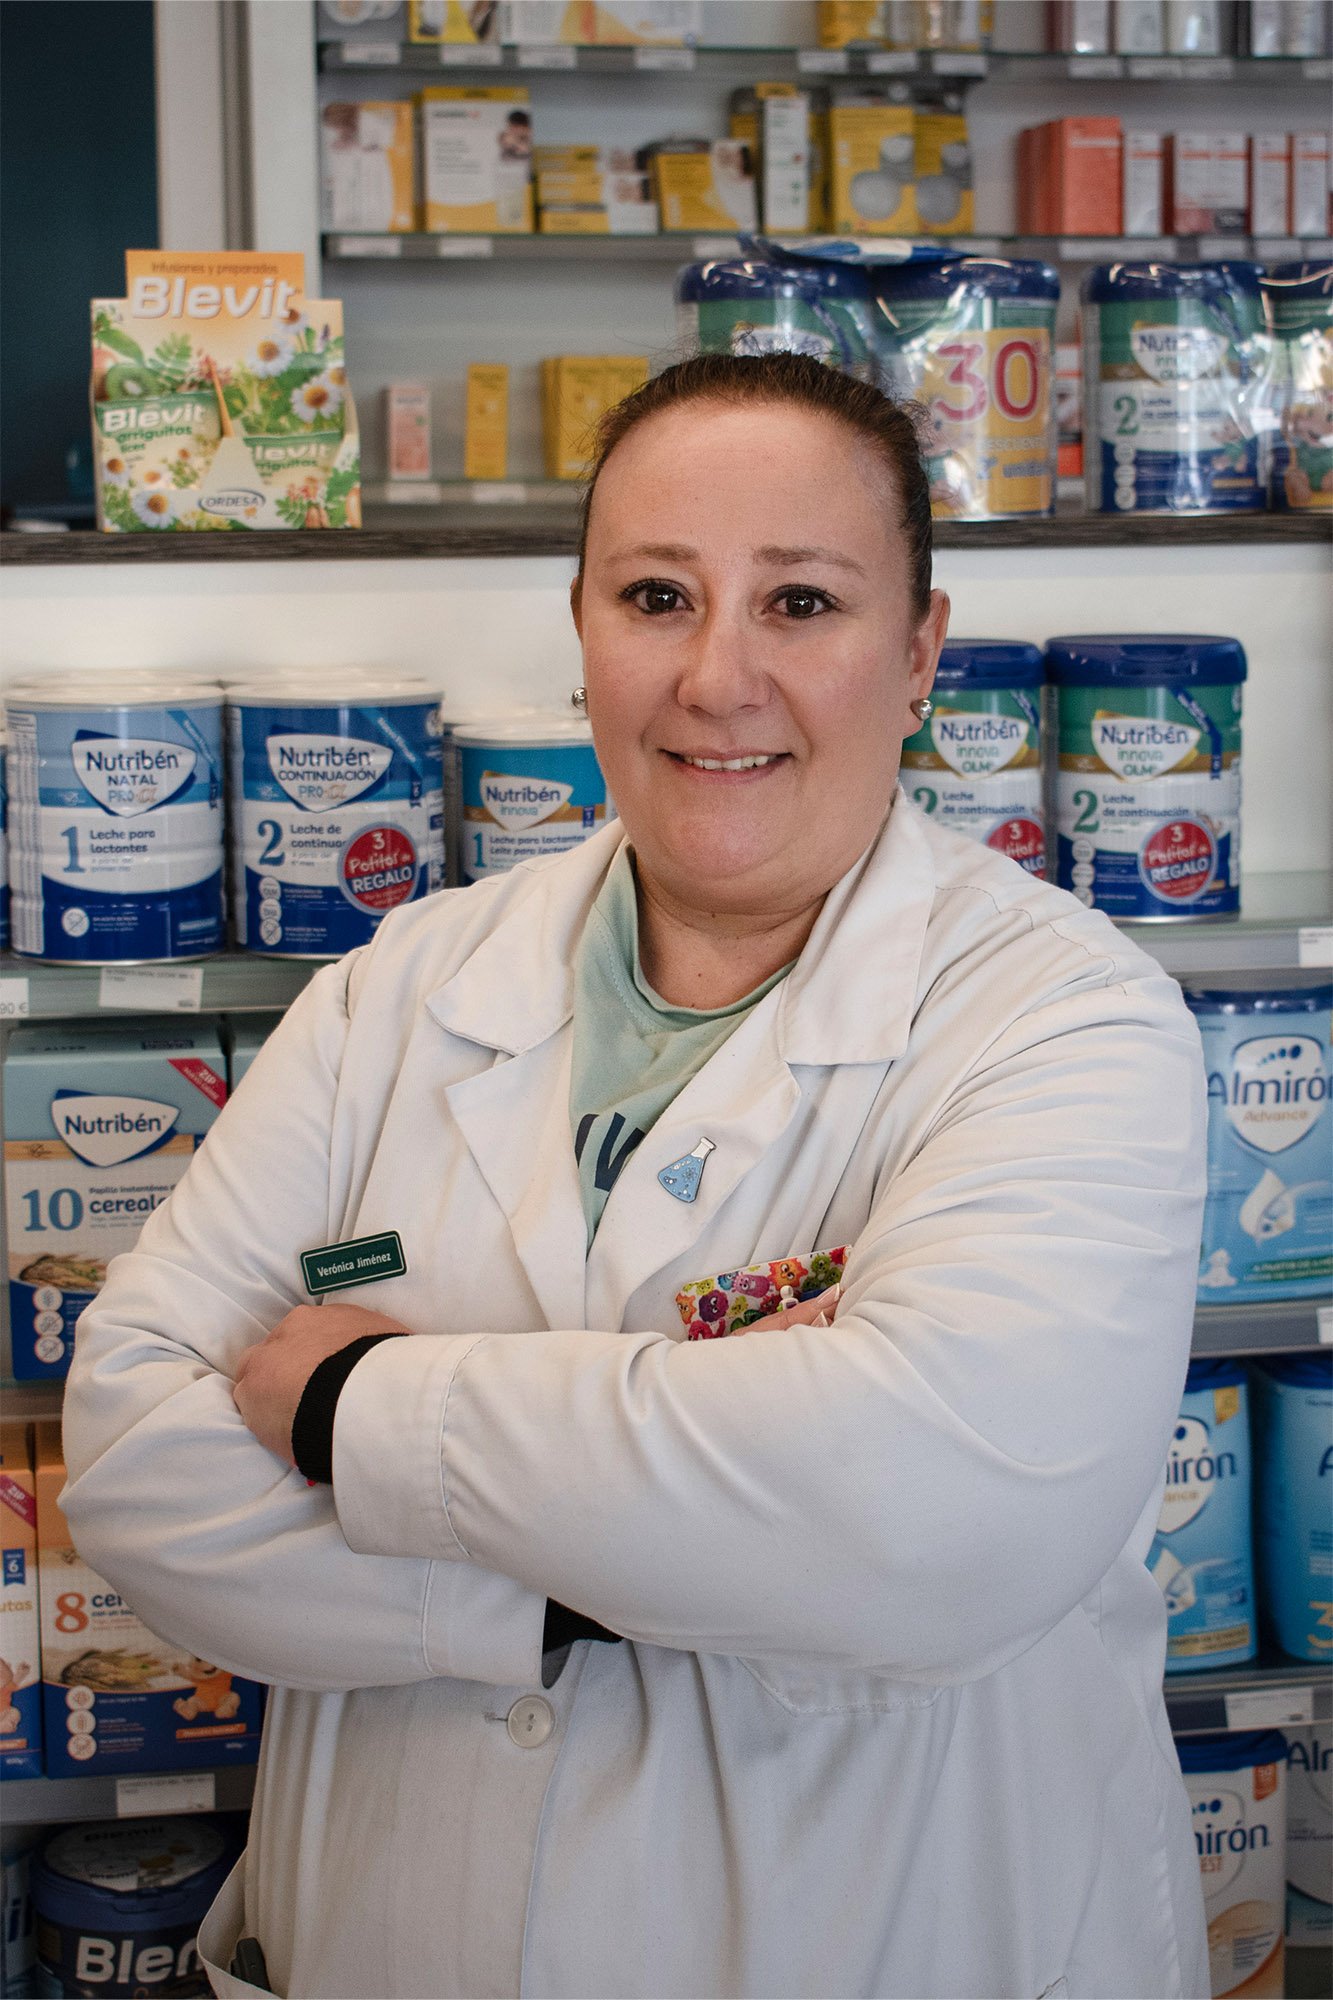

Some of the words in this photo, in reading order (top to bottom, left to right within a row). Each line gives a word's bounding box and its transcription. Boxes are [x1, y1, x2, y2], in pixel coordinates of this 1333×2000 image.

[152, 262, 205, 274] Infusiones
[208, 265, 215, 276] y
[217, 262, 279, 276] preparados
[131, 276, 297, 320] Blevit
[934, 340, 1039, 421] 30
[103, 402, 204, 433] Blevit
[1113, 395, 1139, 436] 2
[204, 496, 259, 507] ORDESA
[940, 719, 1020, 741] Nutribén
[1101, 725, 1188, 745] Nutribén
[86, 749, 179, 771] Nutribén
[279, 745, 372, 767] Nutribén
[956, 744, 999, 758] innova
[1117, 747, 1164, 761] innova
[107, 774, 158, 786] NATAL
[278, 768, 377, 782] CONTINUACIÓN
[485, 785, 561, 802] Nutribén
[942, 791, 975, 802] Leche
[1102, 794, 1136, 804] Leche
[499, 805, 539, 816] innova
[942, 804, 955, 815] de
[957, 803, 1026, 816] continuación
[1072, 789, 1100, 834] 2
[1102, 807, 1116, 817] de
[1118, 806, 1190, 818] continuación
[90, 829, 125, 840] Leche
[128, 829, 156, 843] para
[290, 824, 325, 835] Leche
[327, 824, 342, 834] de
[1009, 821, 1023, 841] 3
[1171, 824, 1186, 843] 3
[60, 825, 86, 873] 1
[90, 843, 149, 854] lactantes
[257, 819, 286, 867] 2
[372, 831, 386, 851] 3
[473, 832, 487, 868] 1
[350, 850, 400, 875] Potitos
[1151, 857, 1209, 883] REGALO
[351, 866, 413, 895] REGALO
[199, 1069, 217, 1085] ZIP
[65, 1112, 162, 1135] Nutribén
[1242, 1109, 1309, 1124] Advance
[22, 1187, 84, 1232] 10
[317, 1261, 355, 1278] Verónica
[357, 1252, 392, 1269] Jiménez
[8, 1559, 19, 1574] 6
[54, 1591, 90, 1634] 8
